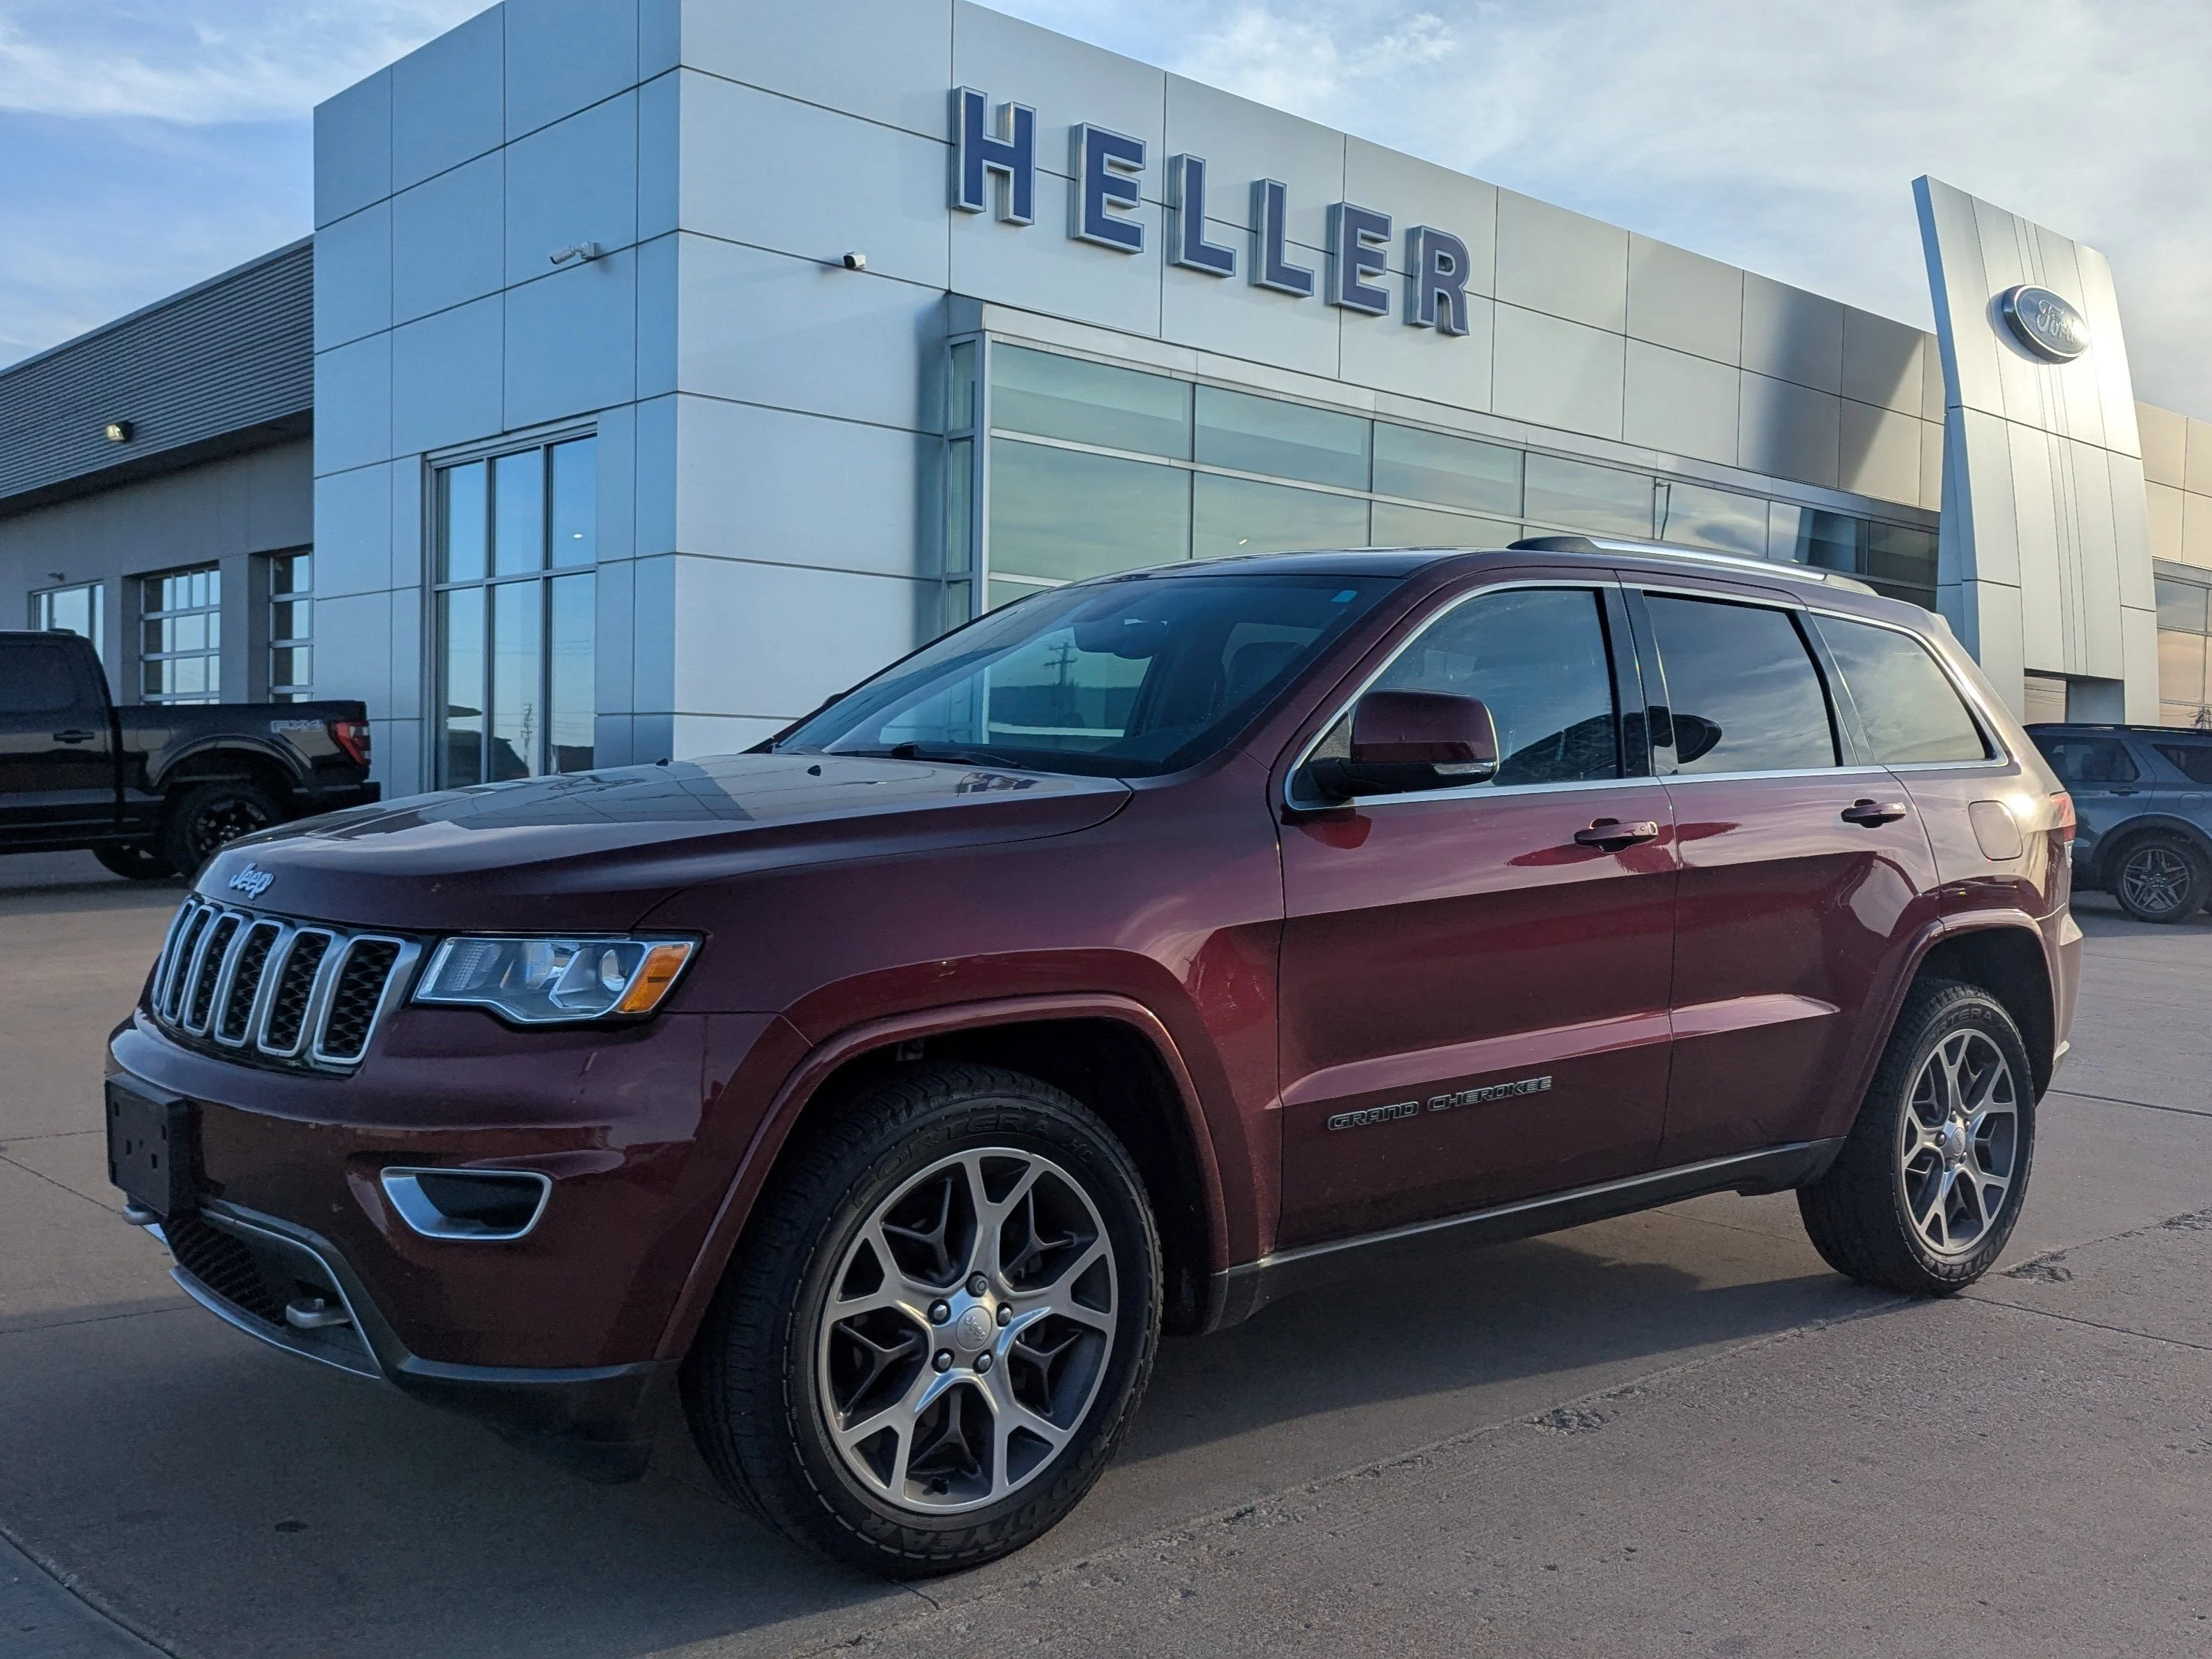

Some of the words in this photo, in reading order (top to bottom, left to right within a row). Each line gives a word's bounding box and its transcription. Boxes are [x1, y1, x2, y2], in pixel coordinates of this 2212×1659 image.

[952, 85, 1470, 336] HELLER
[2036, 298, 2078, 345] Ford
[271, 720, 326, 734] FX4
[229, 863, 274, 900] Jeep
[1328, 1102, 1419, 1131] GRAND
[1427, 1075, 1552, 1112] CHEROKEE
[851, 1112, 1053, 1211] FORTERA
